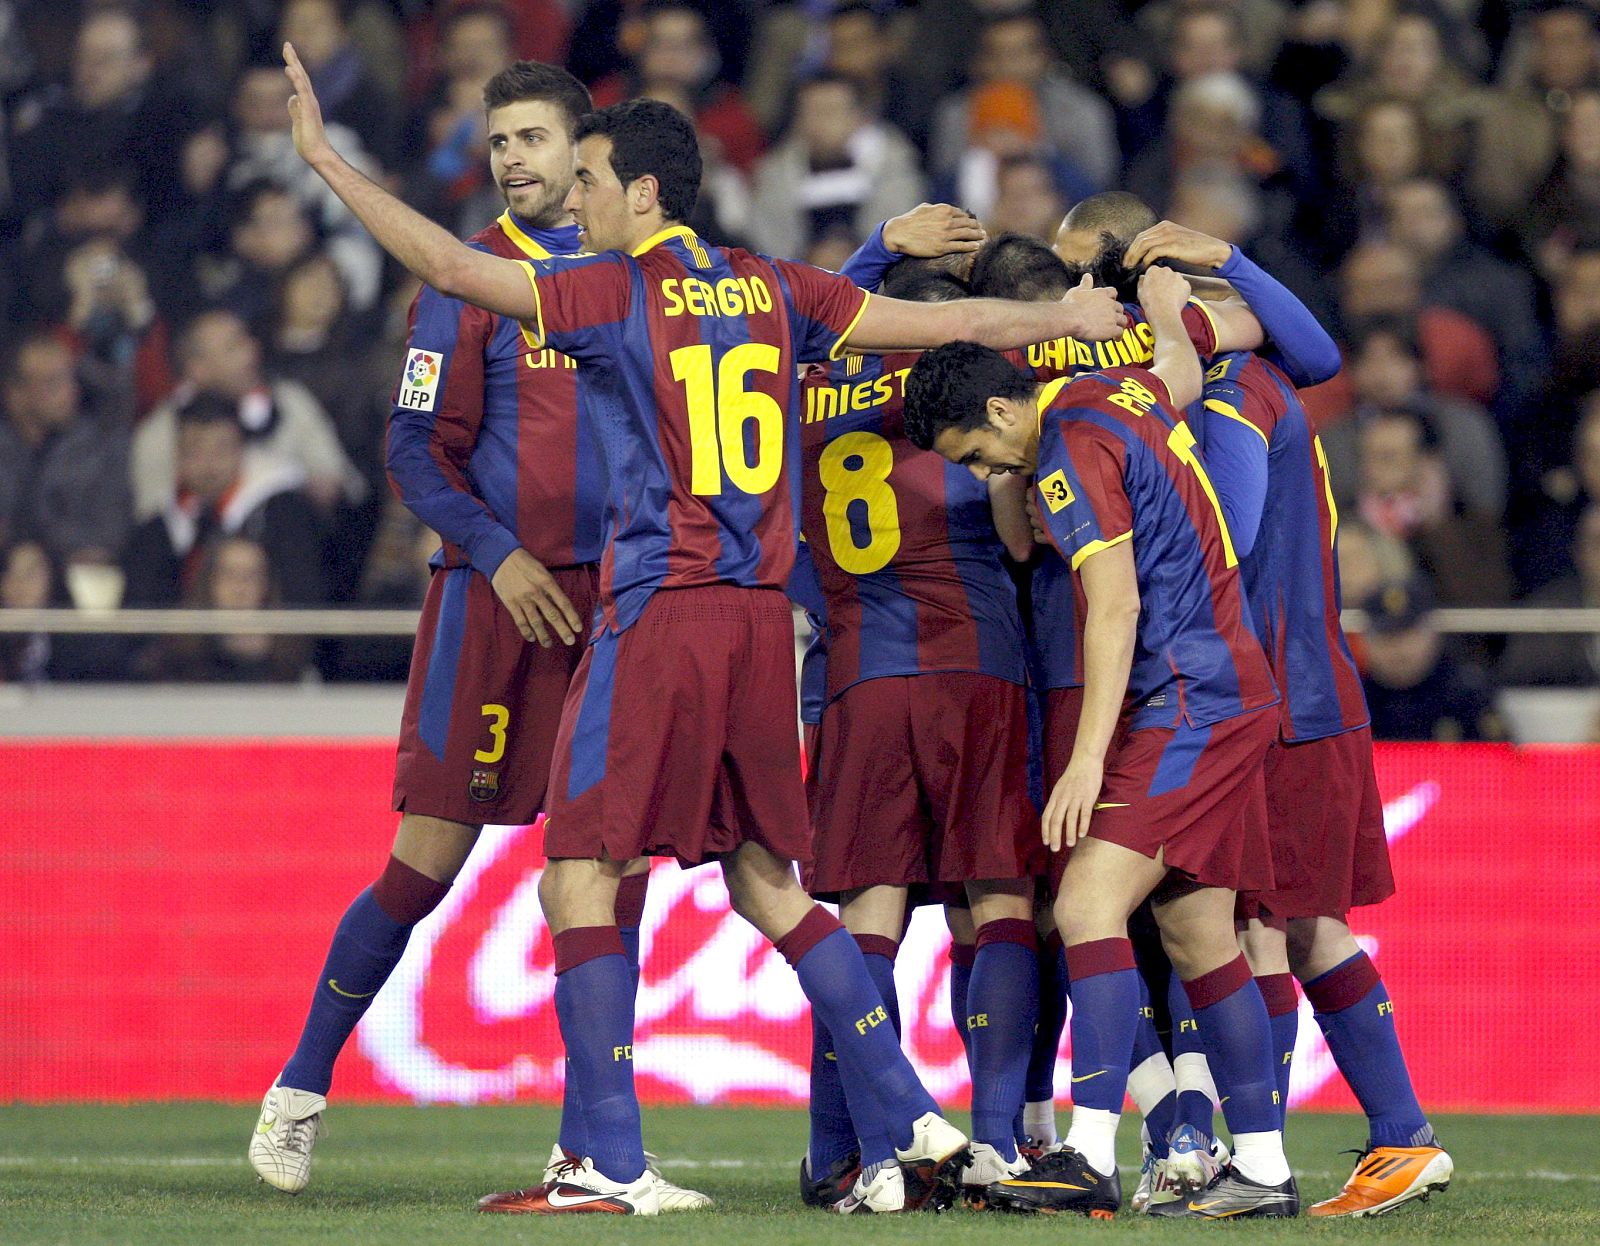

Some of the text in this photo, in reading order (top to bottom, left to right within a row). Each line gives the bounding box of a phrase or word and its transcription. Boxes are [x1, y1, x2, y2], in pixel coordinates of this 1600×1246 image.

[661, 276, 773, 317] SERGIO
[402, 388, 430, 409] LFP
[806, 367, 912, 424] INIEST
[669, 343, 783, 496] 16
[819, 431, 901, 575] 8
[1052, 479, 1068, 501] 3
[474, 703, 510, 763] 3
[854, 1005, 888, 1035] FCB
[967, 1013, 989, 1032] CB
[613, 1045, 633, 1062] FC
